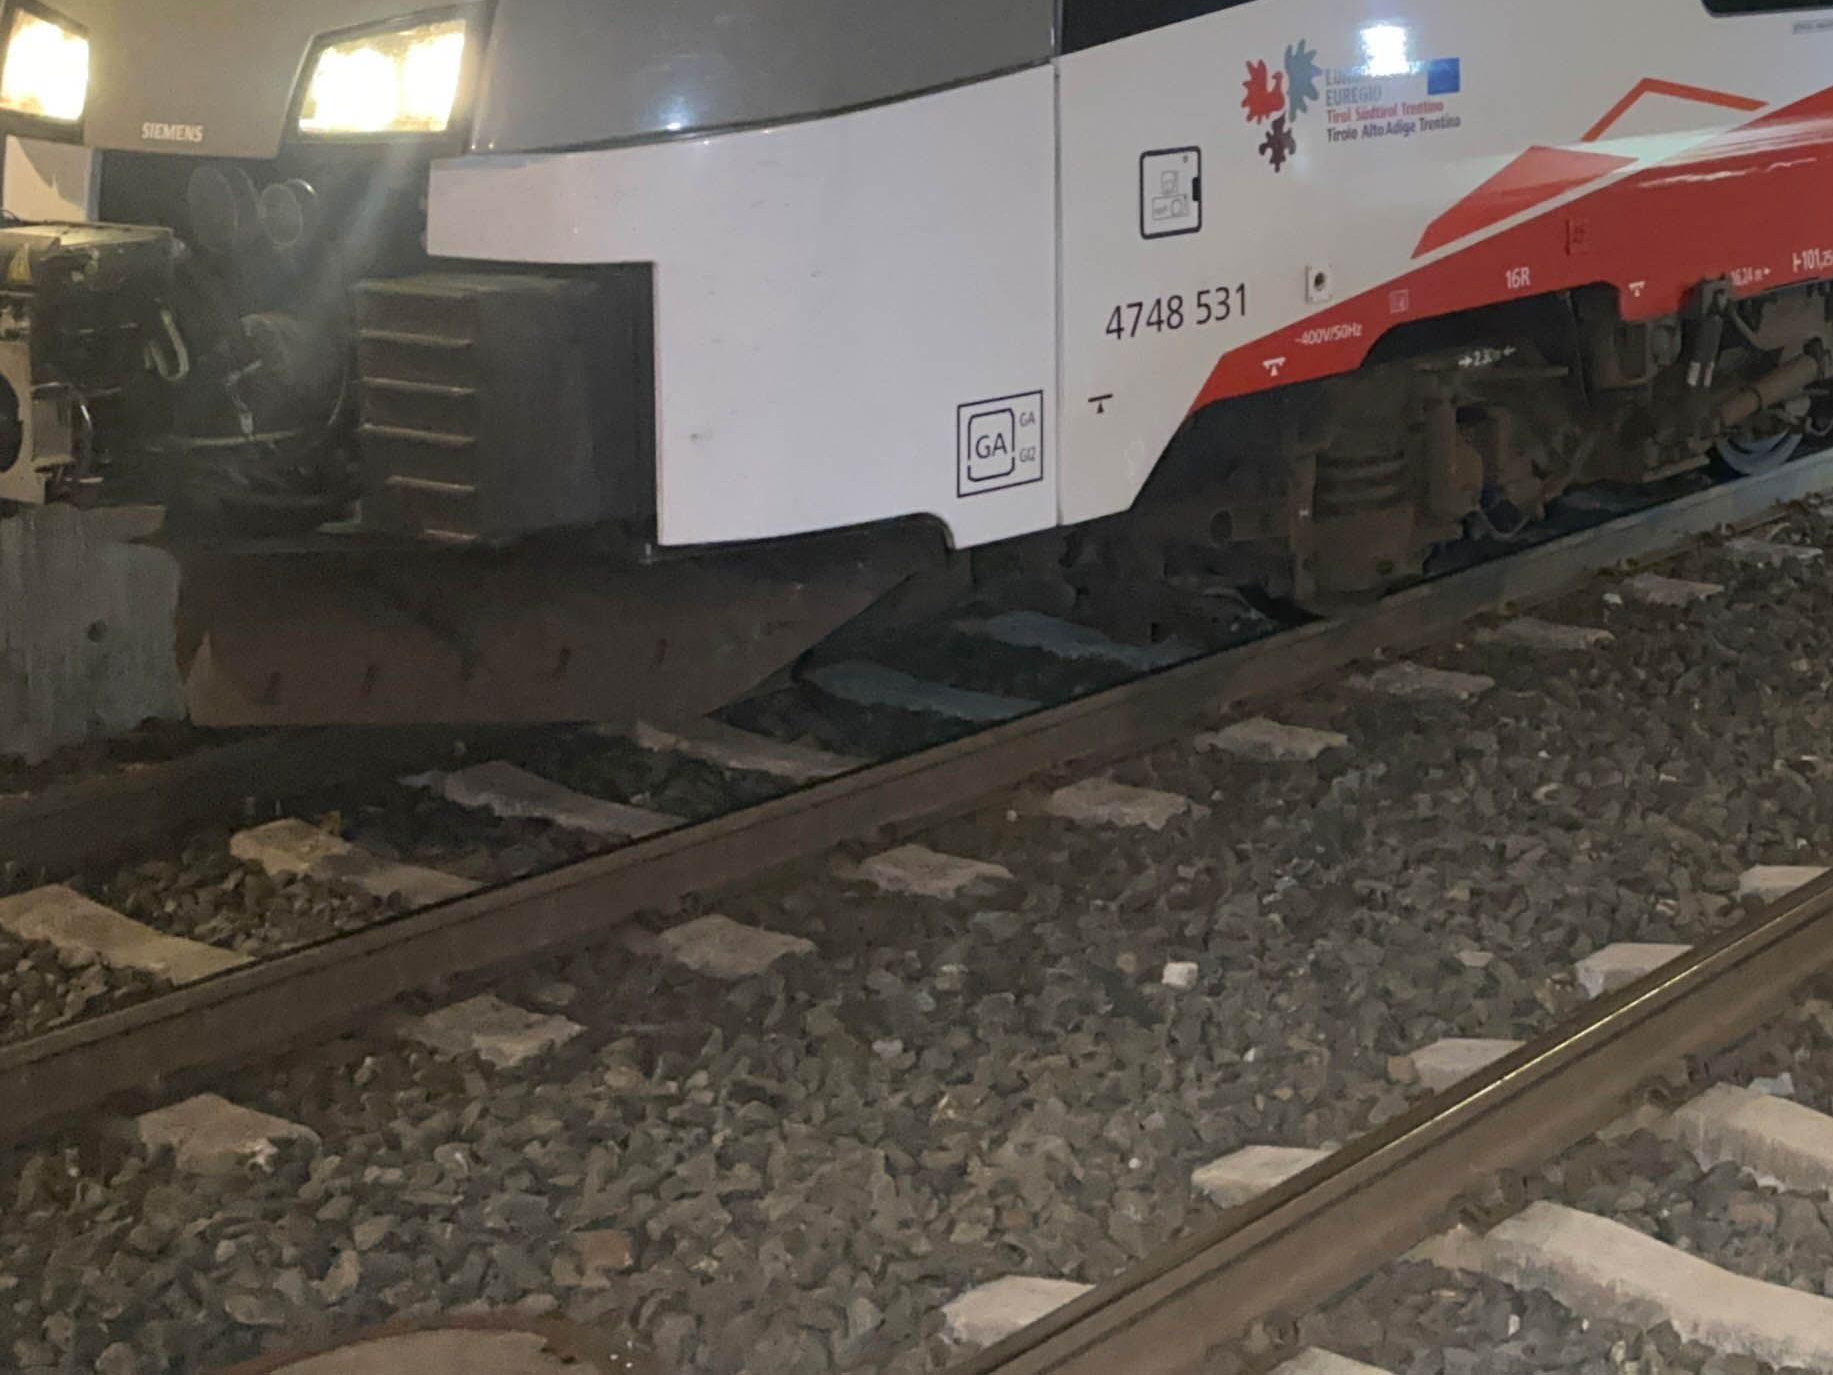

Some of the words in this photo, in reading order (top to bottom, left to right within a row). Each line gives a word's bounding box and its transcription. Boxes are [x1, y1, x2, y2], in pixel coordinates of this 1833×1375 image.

[1326, 86, 1382, 107] EUREGIO
[1328, 109, 1351, 124] Tirol
[142, 122, 204, 142] SIEMENS
[1505, 267, 1530, 289] 16R
[1106, 294, 1184, 340] 4748
[1196, 282, 1245, 325] 531
[976, 432, 1007, 459] GA
